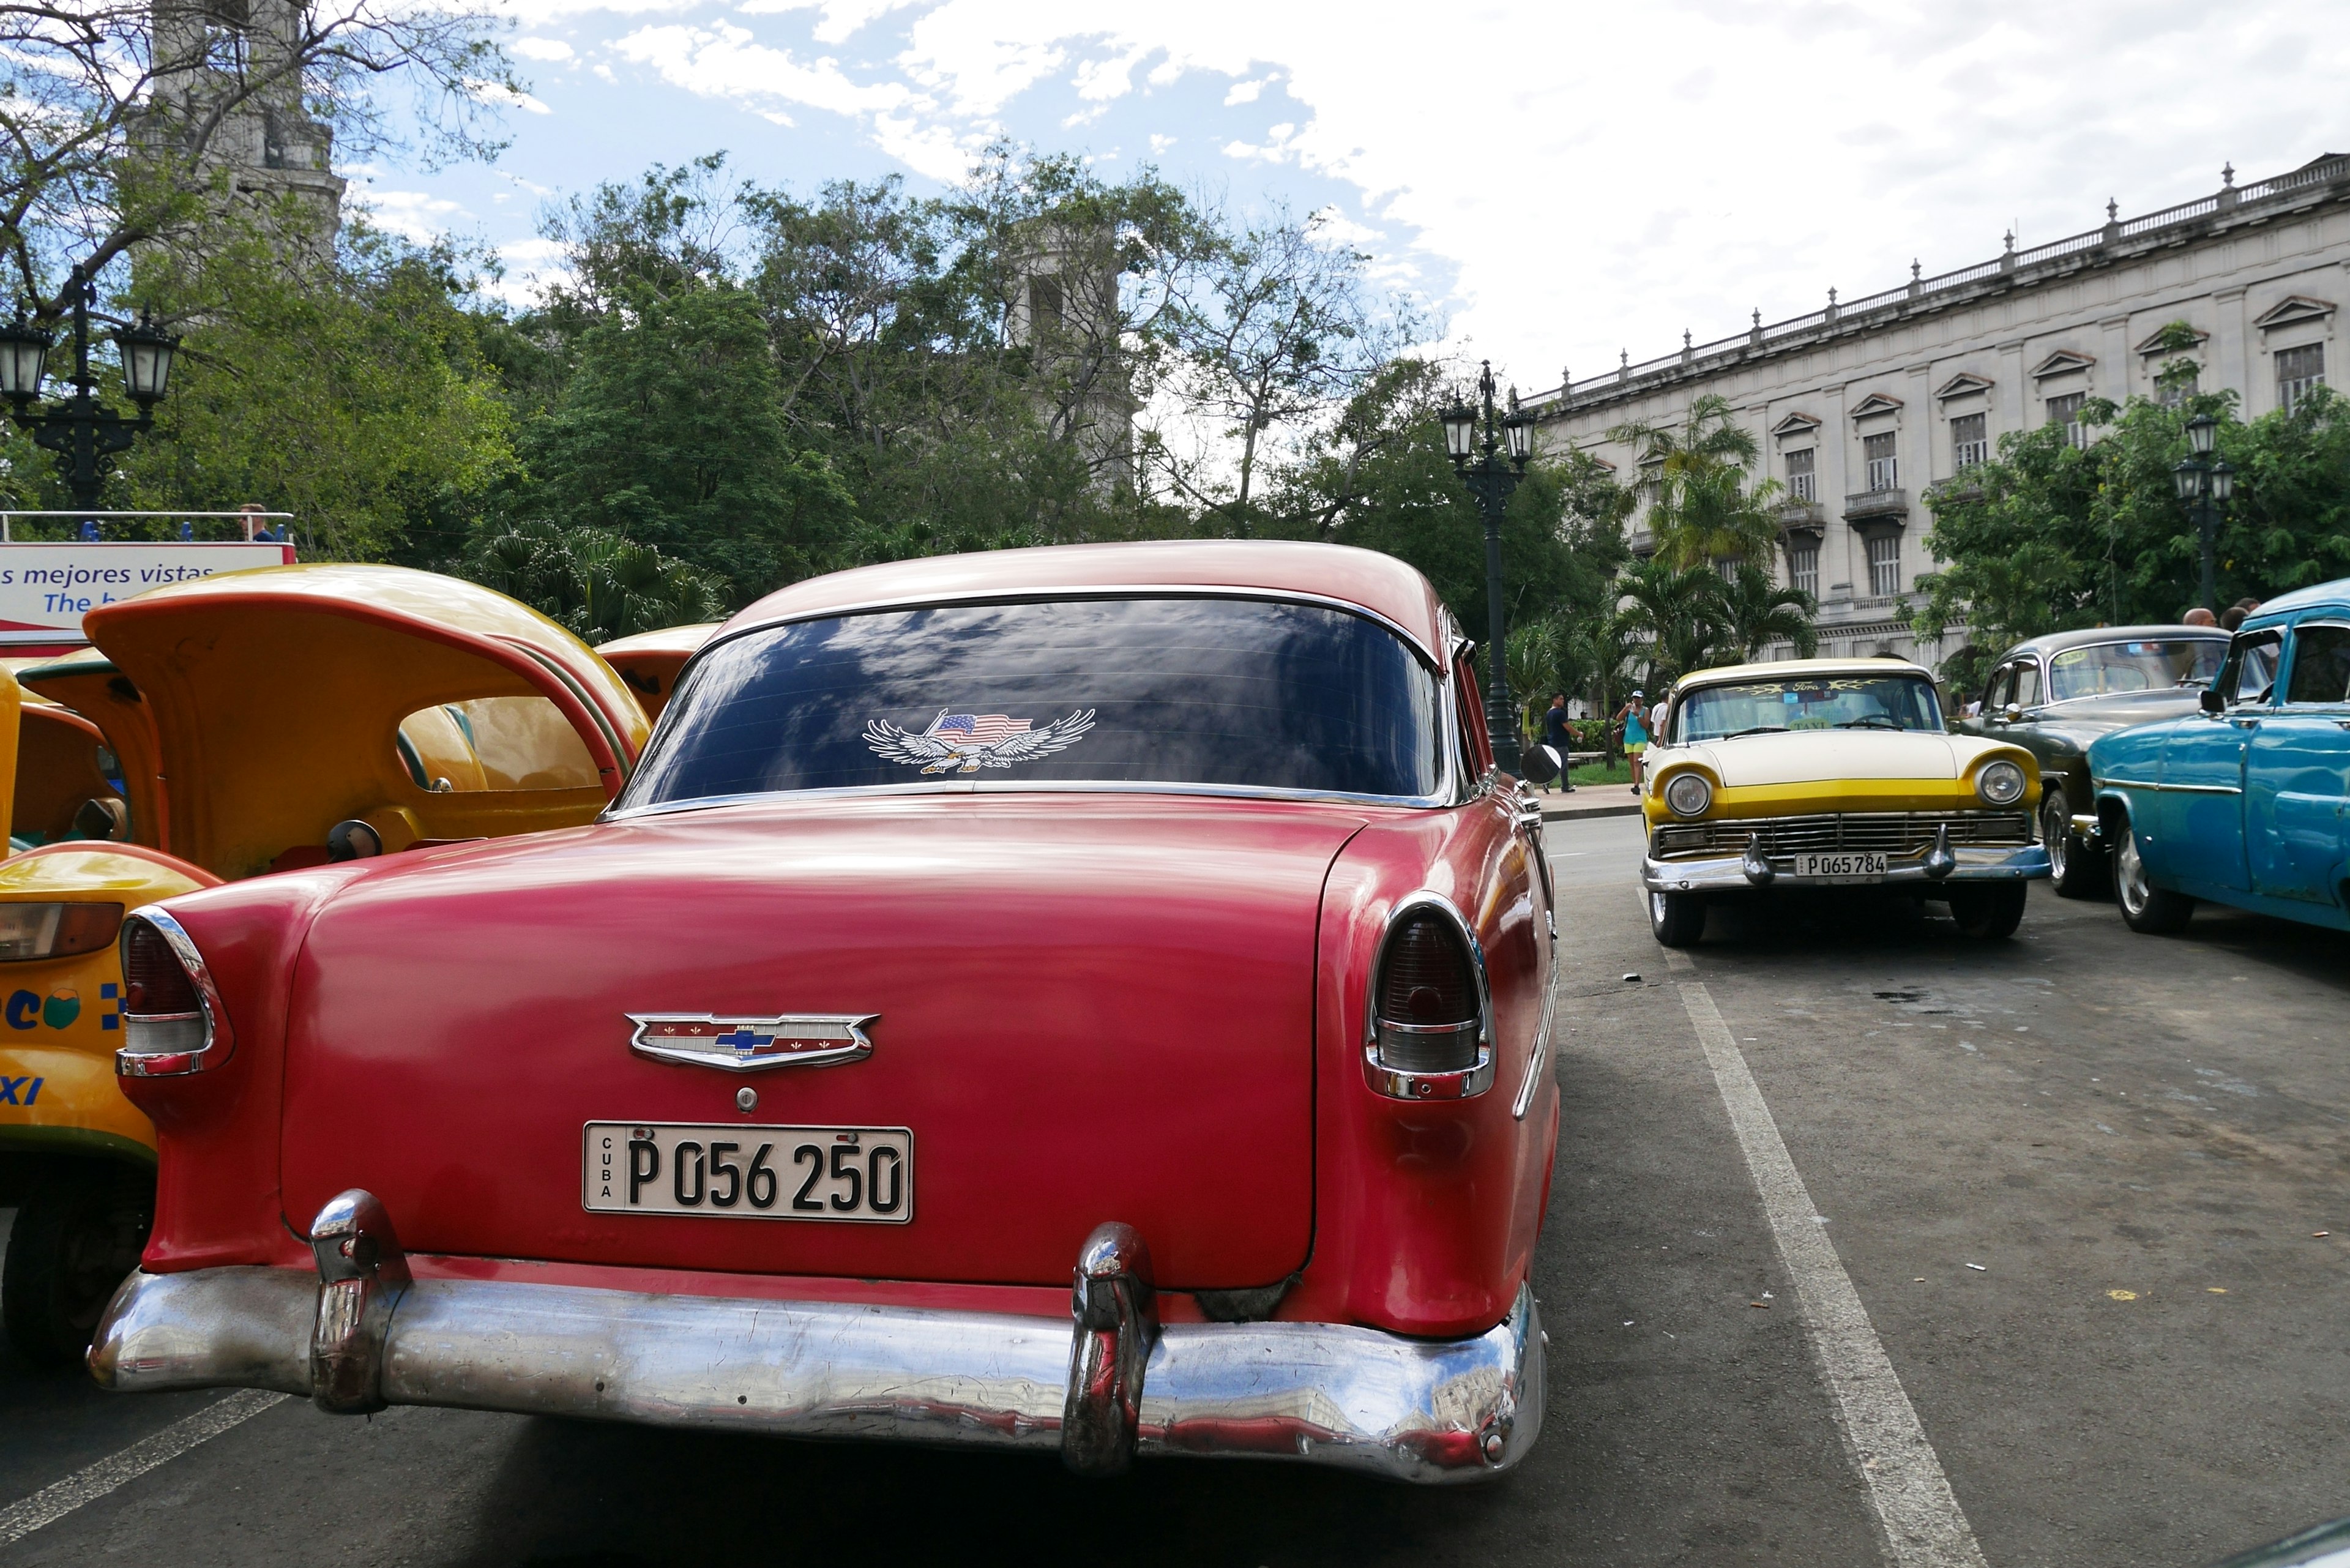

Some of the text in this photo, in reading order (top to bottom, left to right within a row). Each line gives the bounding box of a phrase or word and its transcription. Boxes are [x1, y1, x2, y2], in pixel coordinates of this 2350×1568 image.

[23, 564, 131, 589] mejores
[44, 593, 91, 613] The
[601, 1137, 611, 1197] CUBA
